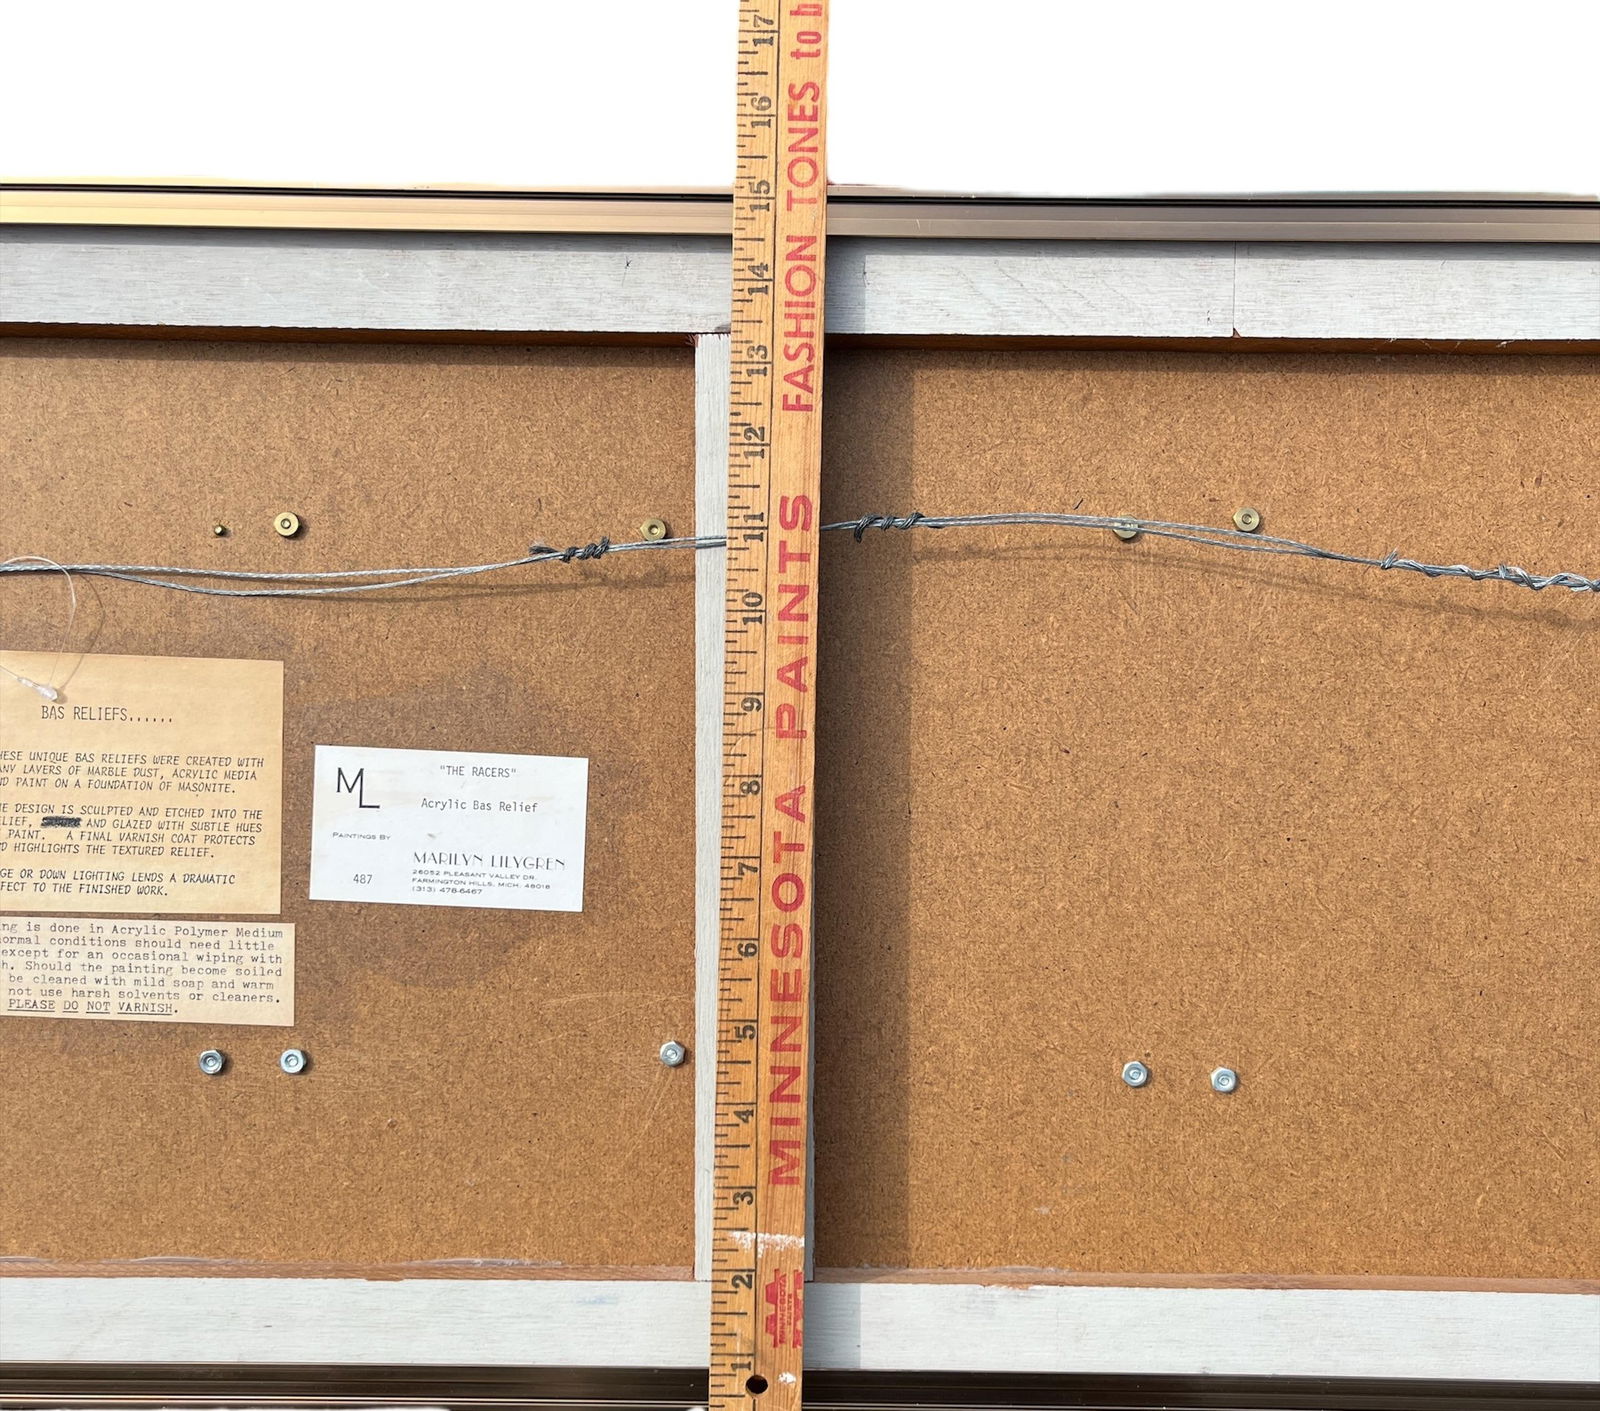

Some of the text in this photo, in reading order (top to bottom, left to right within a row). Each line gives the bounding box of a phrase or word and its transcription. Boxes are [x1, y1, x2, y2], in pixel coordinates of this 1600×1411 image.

[752, 15, 774, 46] 17
[790, 30, 822, 60] to
[751, 96, 772, 129] 16
[786, 81, 820, 212] TONES
[749, 179, 770, 212] 15
[748, 262, 769, 295] 14
[782, 234, 817, 412] FASHION
[747, 345, 767, 376] 13
[744, 426, 765, 459] 12
[744, 512, 764, 542] 11
[742, 592, 763, 626] 10
[775, 495, 813, 739] PAINTS
[41, 706, 64, 719] BAS
[741, 697, 762, 712] 9
[30, 752, 68, 764] UNIQUE
[76, 753, 95, 763] BAS
[102, 754, 147, 764] RELIEFS
[153, 755, 180, 765] WERE
[186, 756, 232, 767] CREATED
[238, 758, 264, 768] WITH
[23, 765, 61, 775] LAYERS
[68, 766, 81, 776] OF
[88, 767, 127, 777] MARBLE
[133, 768, 164, 780] DUST,
[172, 769, 218, 779] ACRYLIC
[224, 770, 257, 781] MEDIA
[16, 778, 48, 788] PAINT
[55, 779, 68, 788] ON
[74, 780, 81, 788] A
[88, 780, 152, 790] FOUNDATION
[159, 782, 172, 791] OF
[178, 783, 236, 793] MASONITE.
[740, 780, 760, 795] 8
[15, 804, 55, 814] DESIGN
[61, 805, 74, 814] IS
[80, 806, 133, 816] SCULPTED
[139, 807, 159, 816] AND
[166, 808, 204, 817] ETCHED
[211, 809, 236, 818] INTO
[243, 810, 262, 820] THE
[421, 798, 538, 813] Acrylic Bas Relief
[87, 819, 106, 828] AND
[112, 819, 152, 829] GLAZED
[158, 821, 184, 830] WITH
[190, 822, 229, 832] SUBTLE
[236, 823, 262, 833] HUES
[8, 830, 255, 845] PAINT. A FINAL VARNISH COAT PROTECTS
[14, 842, 79, 854] HIGHLIGHTS
[86, 845, 106, 854] THE
[112, 845, 164, 855] TEXTURED
[170, 847, 214, 858] RELIEF.
[413, 852, 565, 871] MARILYN LILYGREN
[738, 862, 758, 875] 7
[20, 869, 33, 879] OR
[40, 870, 66, 879] DOWN
[73, 871, 125, 881] LIGHTING
[132, 872, 163, 882] LENDS
[170, 874, 176, 882] A
[183, 874, 235, 884] DRAMATIC
[353, 874, 372, 884] 487
[33, 883, 46, 892] TO
[53, 883, 72, 893] THE
[79, 884, 131, 894] FINISHED
[137, 886, 168, 895] WORK.
[0, 921, 283, 939] ng is done in Acrylic Polymer Medium
[0, 934, 274, 951] ormal conditions should need little
[738, 943, 758, 958] 6
[1, 948, 282, 965] except for an occasional wiping with
[25, 961, 71, 972] Should
[81, 963, 102, 972] the
[112, 964, 173, 976] painting
[181, 965, 226, 975] become
[236, 967, 282, 977] soiled
[9, 974, 274, 990] be cleaned with mild soap and warm
[768, 785, 806, 1186] MINNESOTA
[8, 986, 280, 1004] not use harsh solvents or cleaners.
[8, 999, 178, 1014] PLEASE DO NOT VARNISH.
[735, 1025, 756, 1039] 5
[734, 1109, 754, 1124] 4
[733, 1192, 753, 1205] 3
[732, 1274, 753, 1289] 2
[731, 1361, 752, 1371] 1
